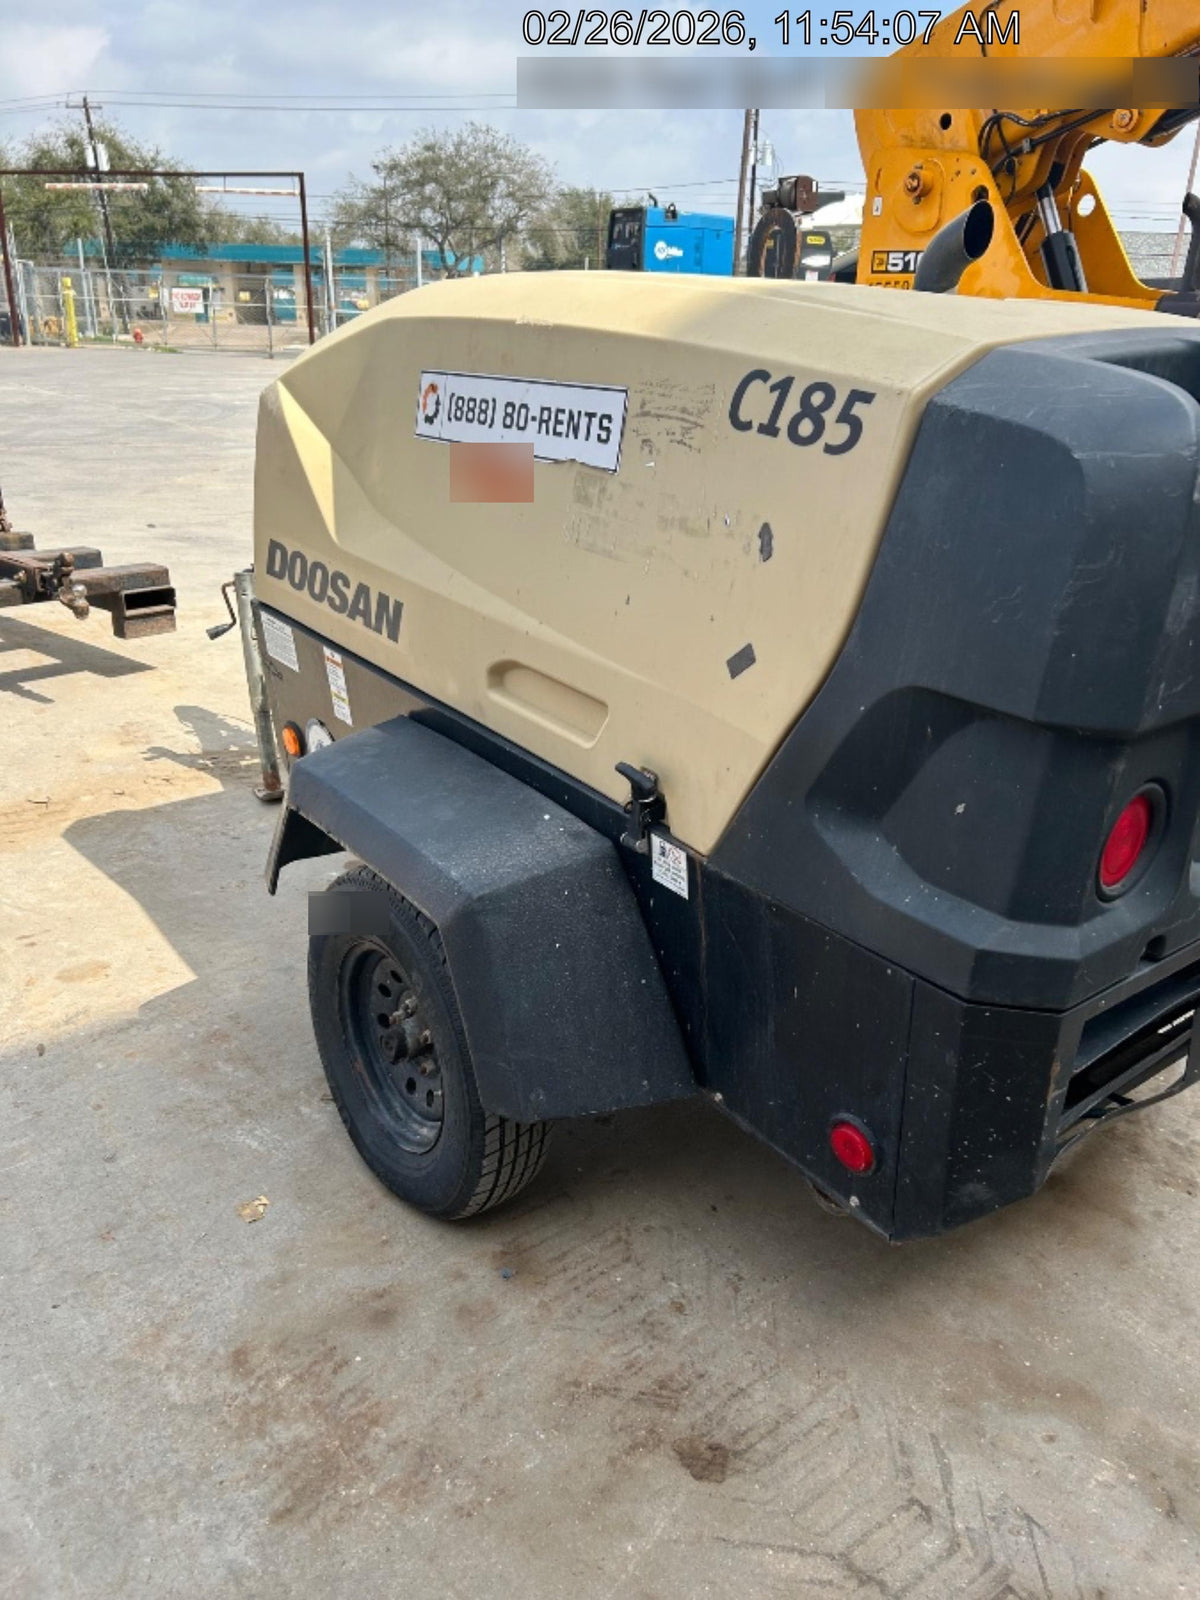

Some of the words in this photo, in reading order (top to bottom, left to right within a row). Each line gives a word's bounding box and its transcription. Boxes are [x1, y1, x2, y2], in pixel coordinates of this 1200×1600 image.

[447, 392, 497, 429] (888)
[502, 400, 614, 445] 80-RENTS
[728, 369, 877, 456] C185
[266, 538, 404, 645] DOOSAN
